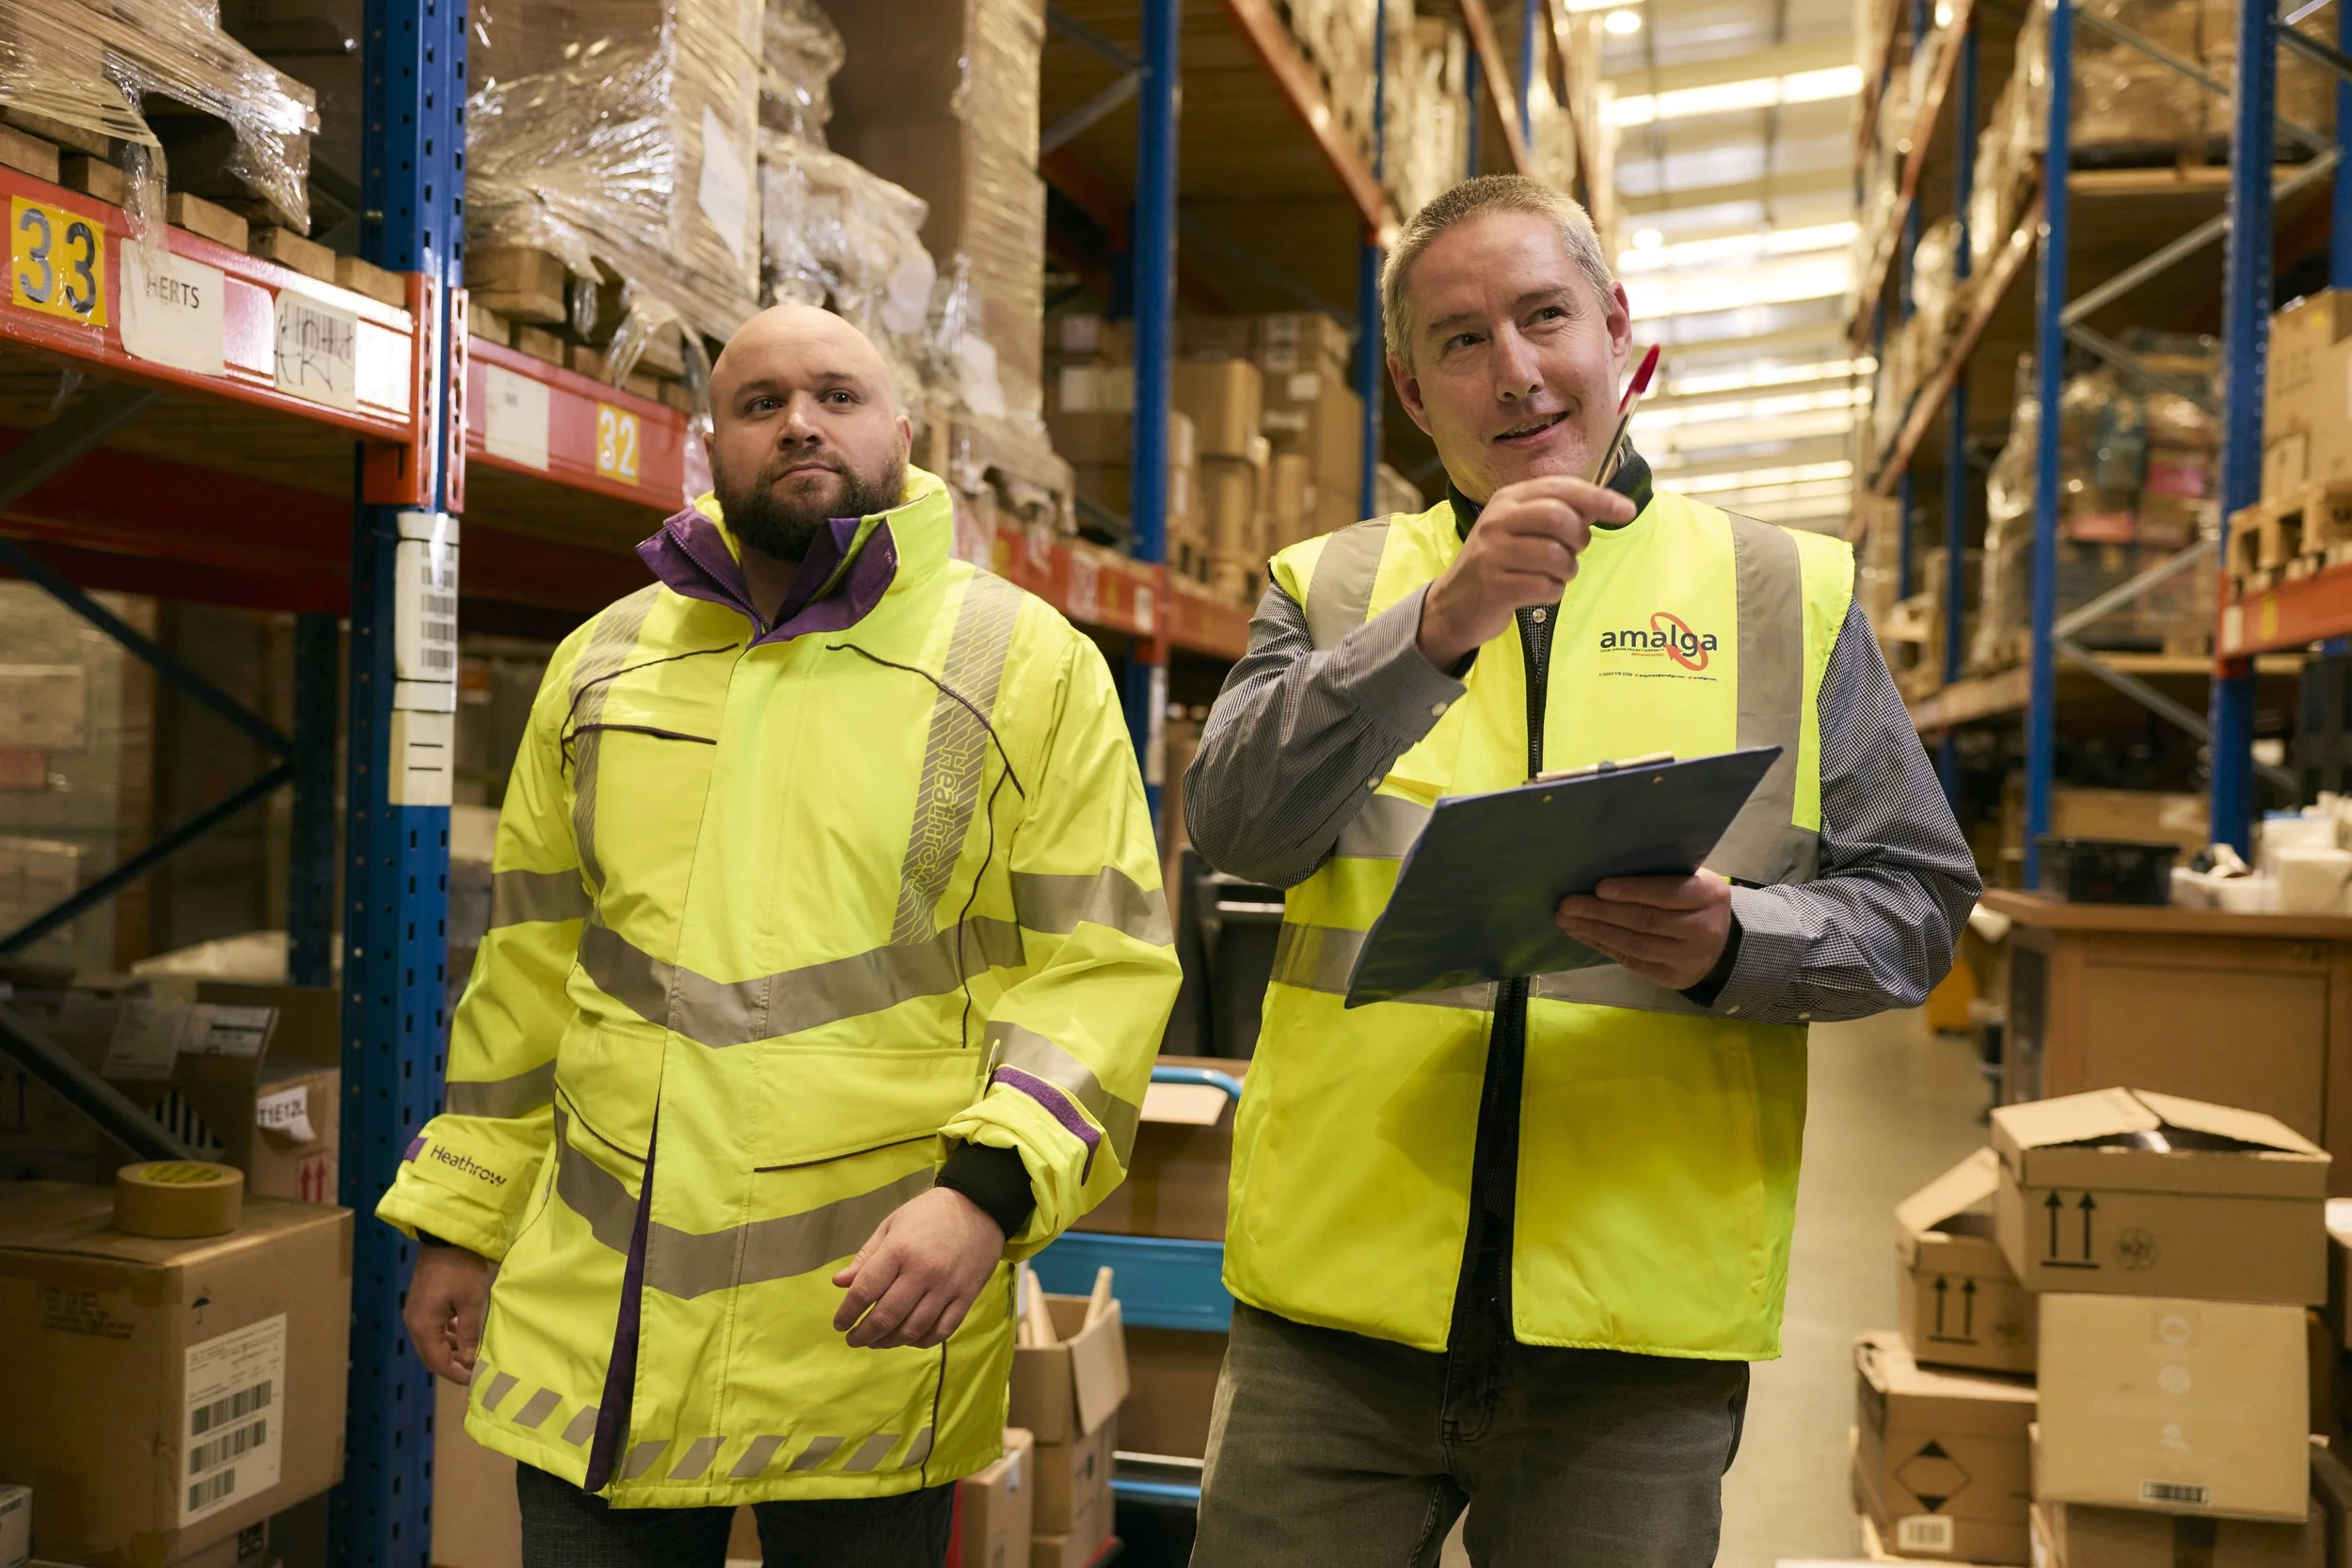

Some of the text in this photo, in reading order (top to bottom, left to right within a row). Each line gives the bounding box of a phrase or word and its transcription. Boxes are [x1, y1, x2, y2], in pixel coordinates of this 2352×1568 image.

[19, 208, 97, 314] 33
[146, 272, 199, 309] HERTS
[599, 408, 636, 479] 32
[1599, 624, 1718, 657] amalga
[910, 748, 968, 895] Heathrow
[430, 1144, 508, 1187] Heathrow
